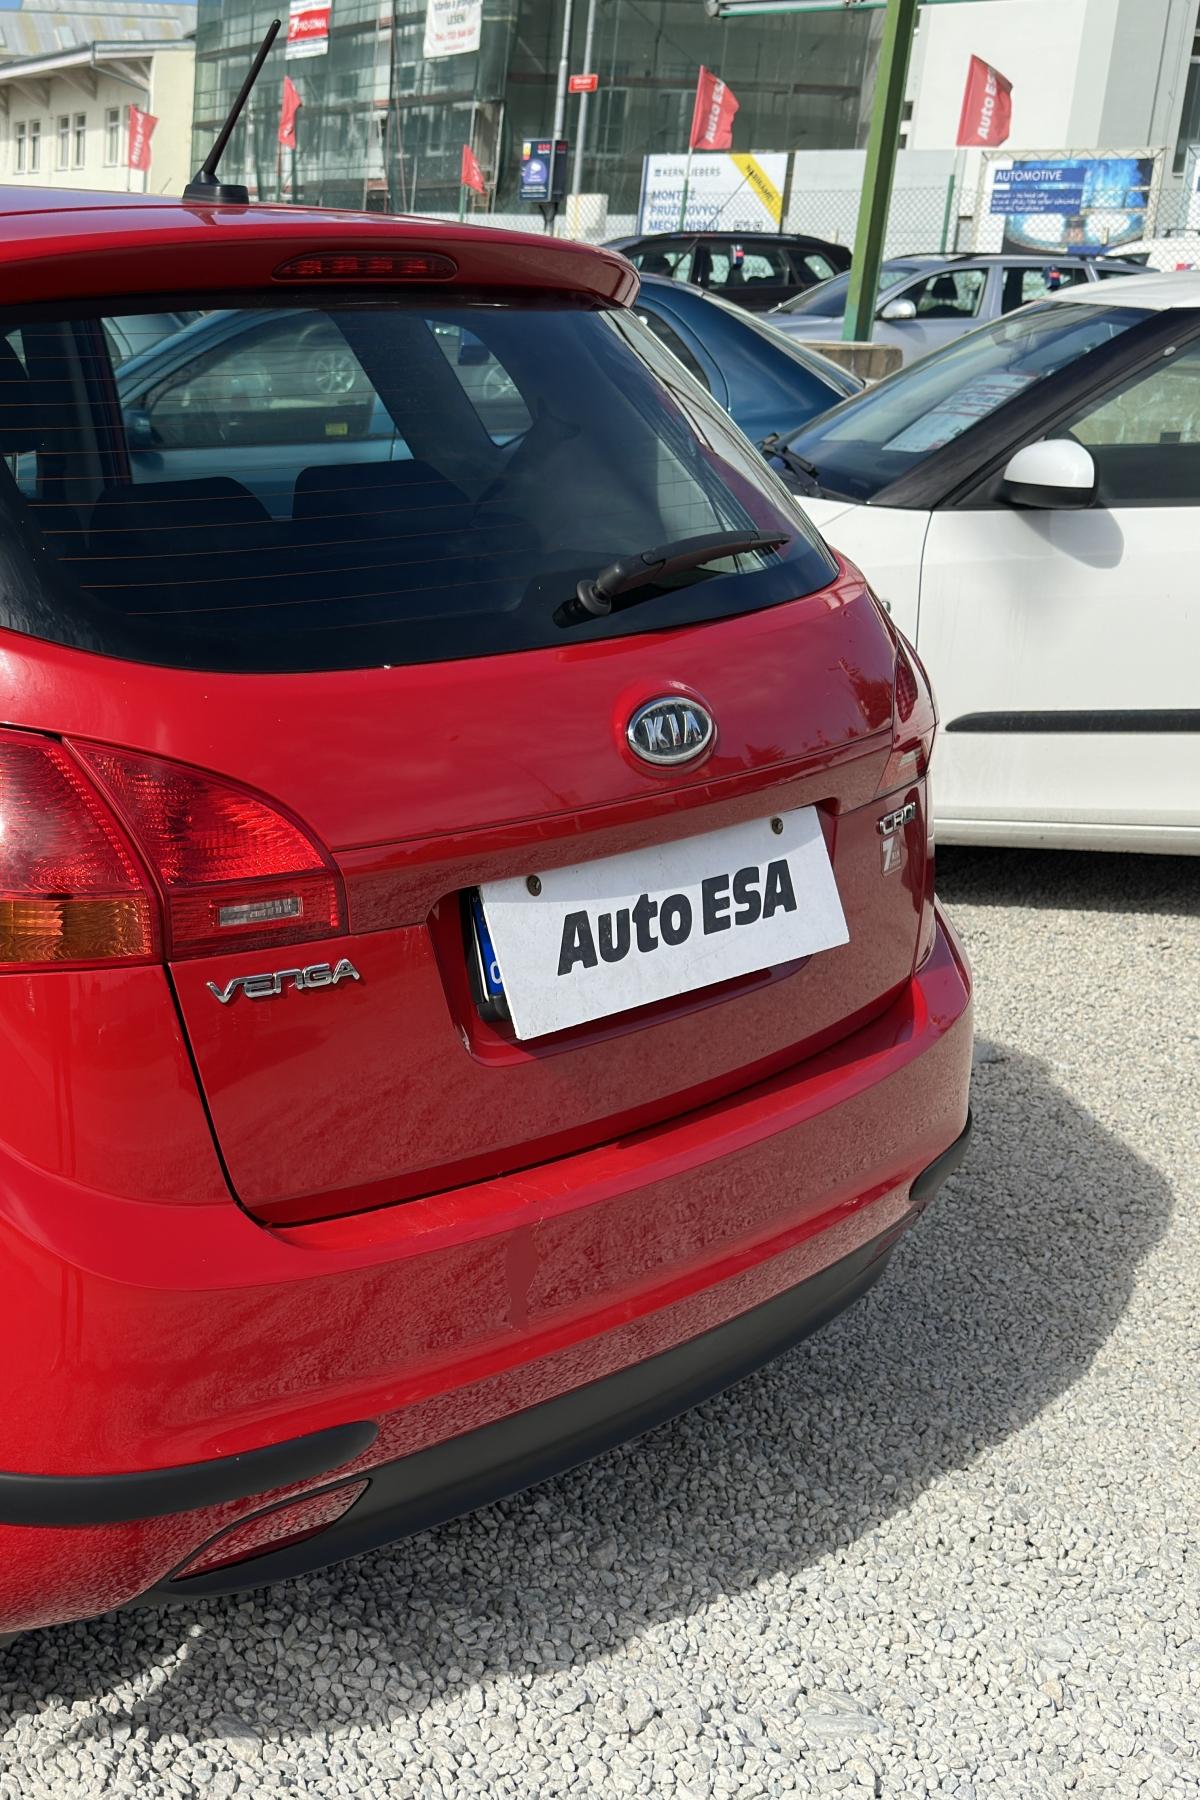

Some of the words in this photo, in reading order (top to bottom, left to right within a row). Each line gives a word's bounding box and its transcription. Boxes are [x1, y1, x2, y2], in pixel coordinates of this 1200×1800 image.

[705, 103, 721, 144] Auto
[977, 96, 994, 140] Auto
[662, 168, 686, 178] KERN
[994, 170, 1063, 182] AUTOMOTIVE
[651, 188, 697, 202] MONTŽ
[642, 710, 703, 751] KIA
[557, 893, 693, 977] Auto
[701, 858, 798, 936] ESA
